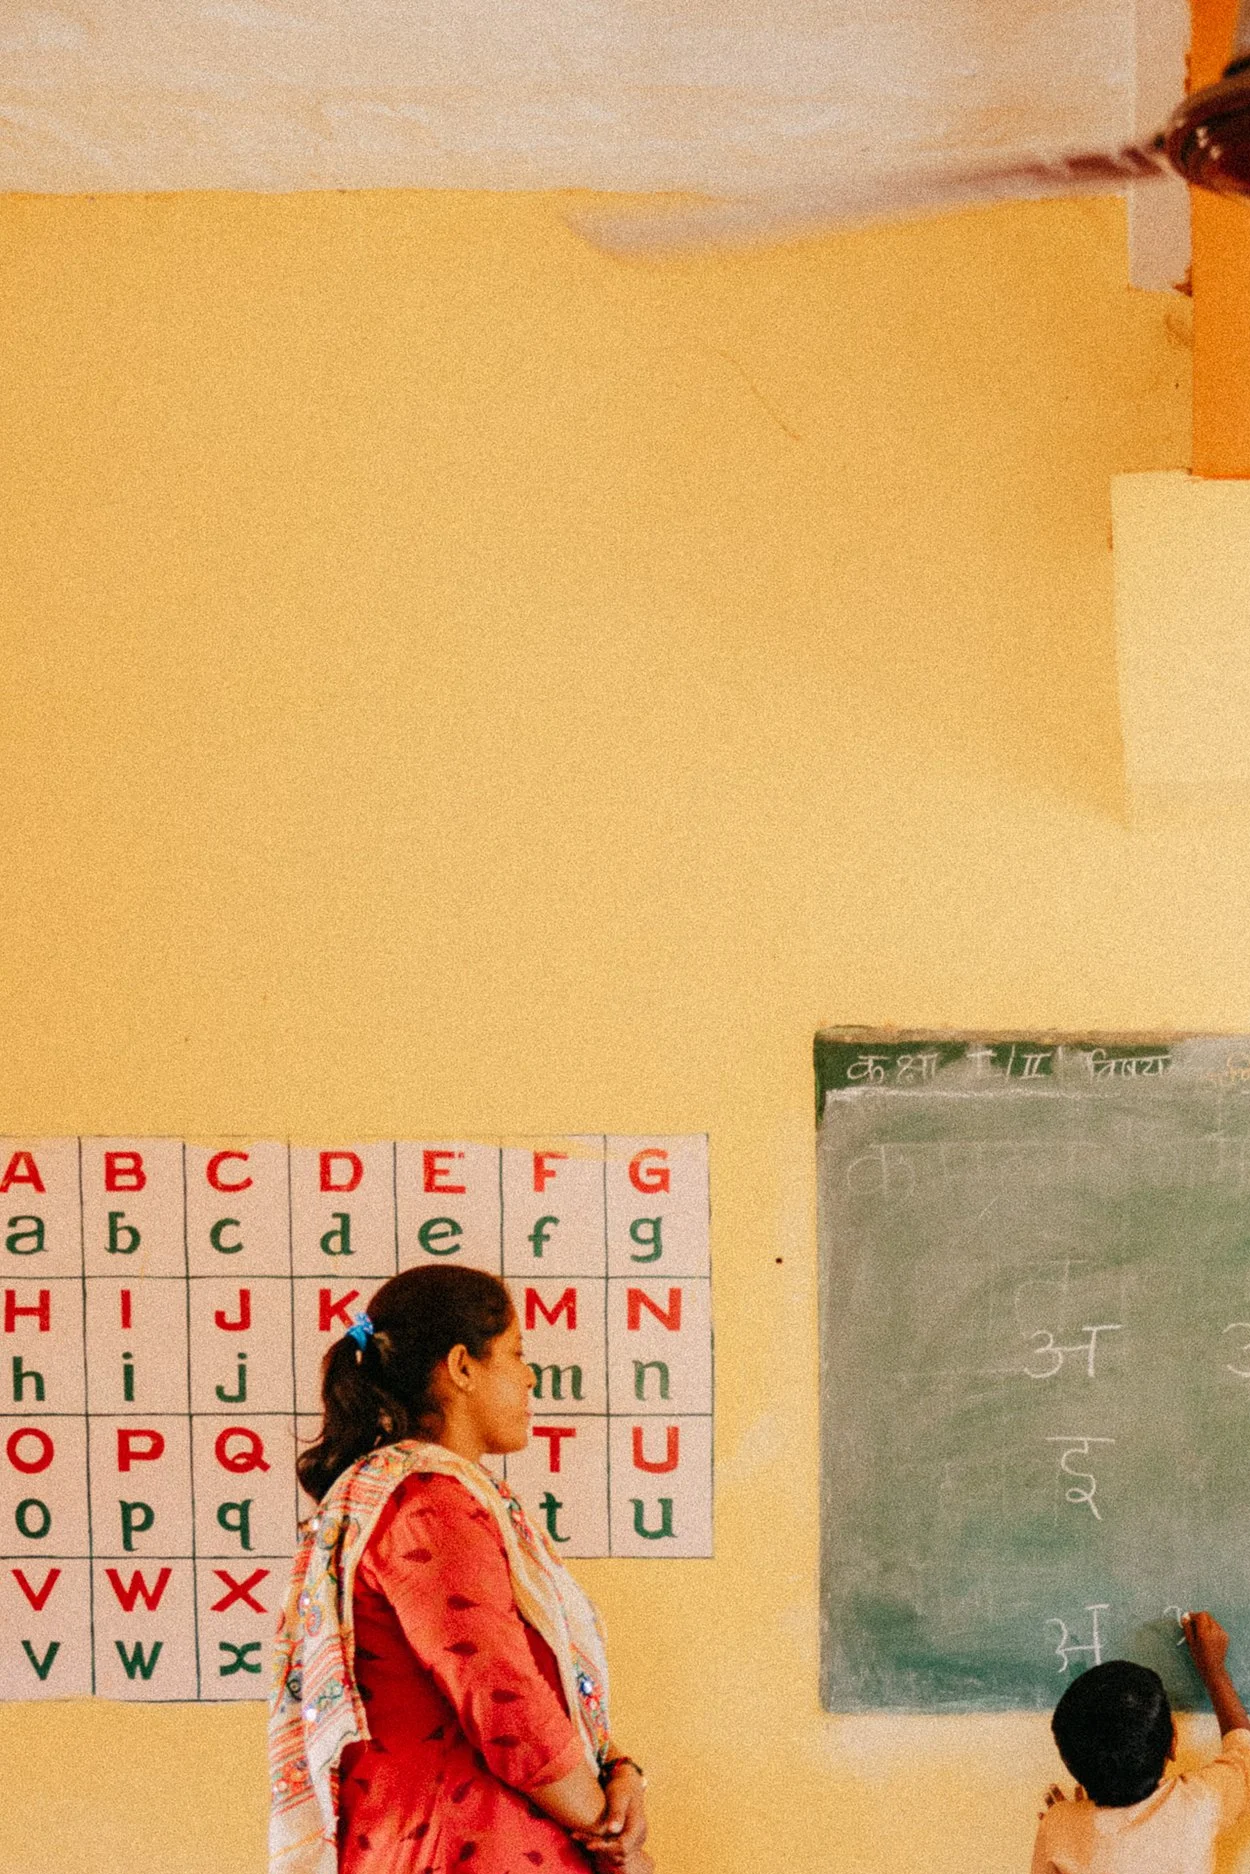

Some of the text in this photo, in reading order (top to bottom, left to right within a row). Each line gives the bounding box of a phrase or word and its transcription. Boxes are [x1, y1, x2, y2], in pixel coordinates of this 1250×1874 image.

[0, 1149, 670, 1194] A B C D E F G
[4, 1216, 47, 1255] a
[106, 1212, 142, 1254] b
[320, 1213, 352, 1255] d
[418, 1218, 462, 1255] e
[528, 1216, 560, 1256] f
[630, 1218, 663, 1262] g
[3, 1289, 51, 1334] H
[214, 1288, 252, 1332] J
[318, 1288, 360, 1331] K
[524, 1287, 577, 1331] M
[627, 1288, 681, 1331] N
[13, 1352, 671, 1402] h i j m n
[5, 1425, 679, 1475] O P Q T U
[1045, 1435, 1116, 1520] इ
[120, 1501, 154, 1551] p
[217, 1500, 253, 1550] q
[538, 1493, 571, 1542] t
[631, 1499, 677, 1539] u
